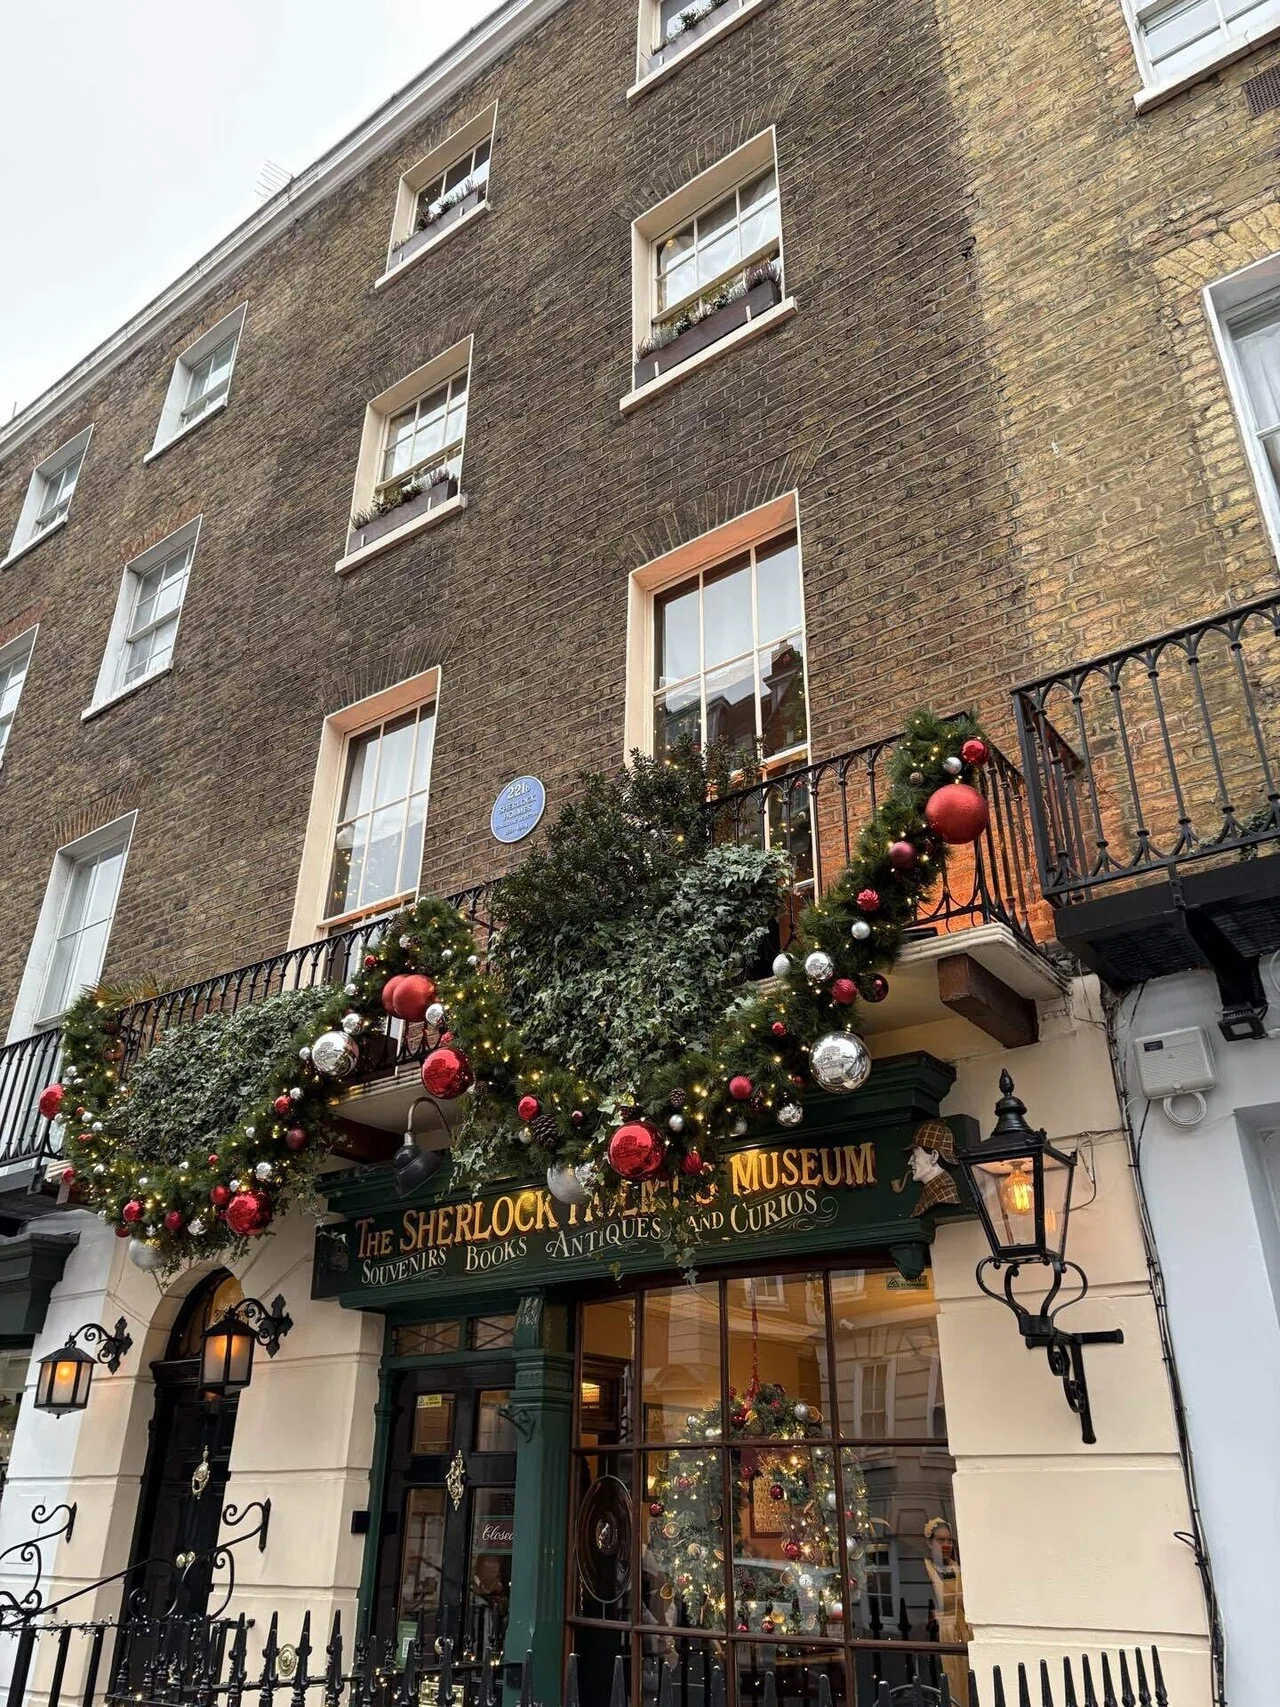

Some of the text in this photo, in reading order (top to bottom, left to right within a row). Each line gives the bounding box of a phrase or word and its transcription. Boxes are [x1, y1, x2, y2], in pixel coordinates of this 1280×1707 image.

[507, 782, 532, 799] 221b
[355, 1217, 395, 1258] THE
[401, 1190, 560, 1252] SHERLOCK
[730, 1142, 877, 1196] MUSEUM
[361, 1189, 818, 1286] SOUVENIRS BOOKS ANTIQUES AND CURIOS
